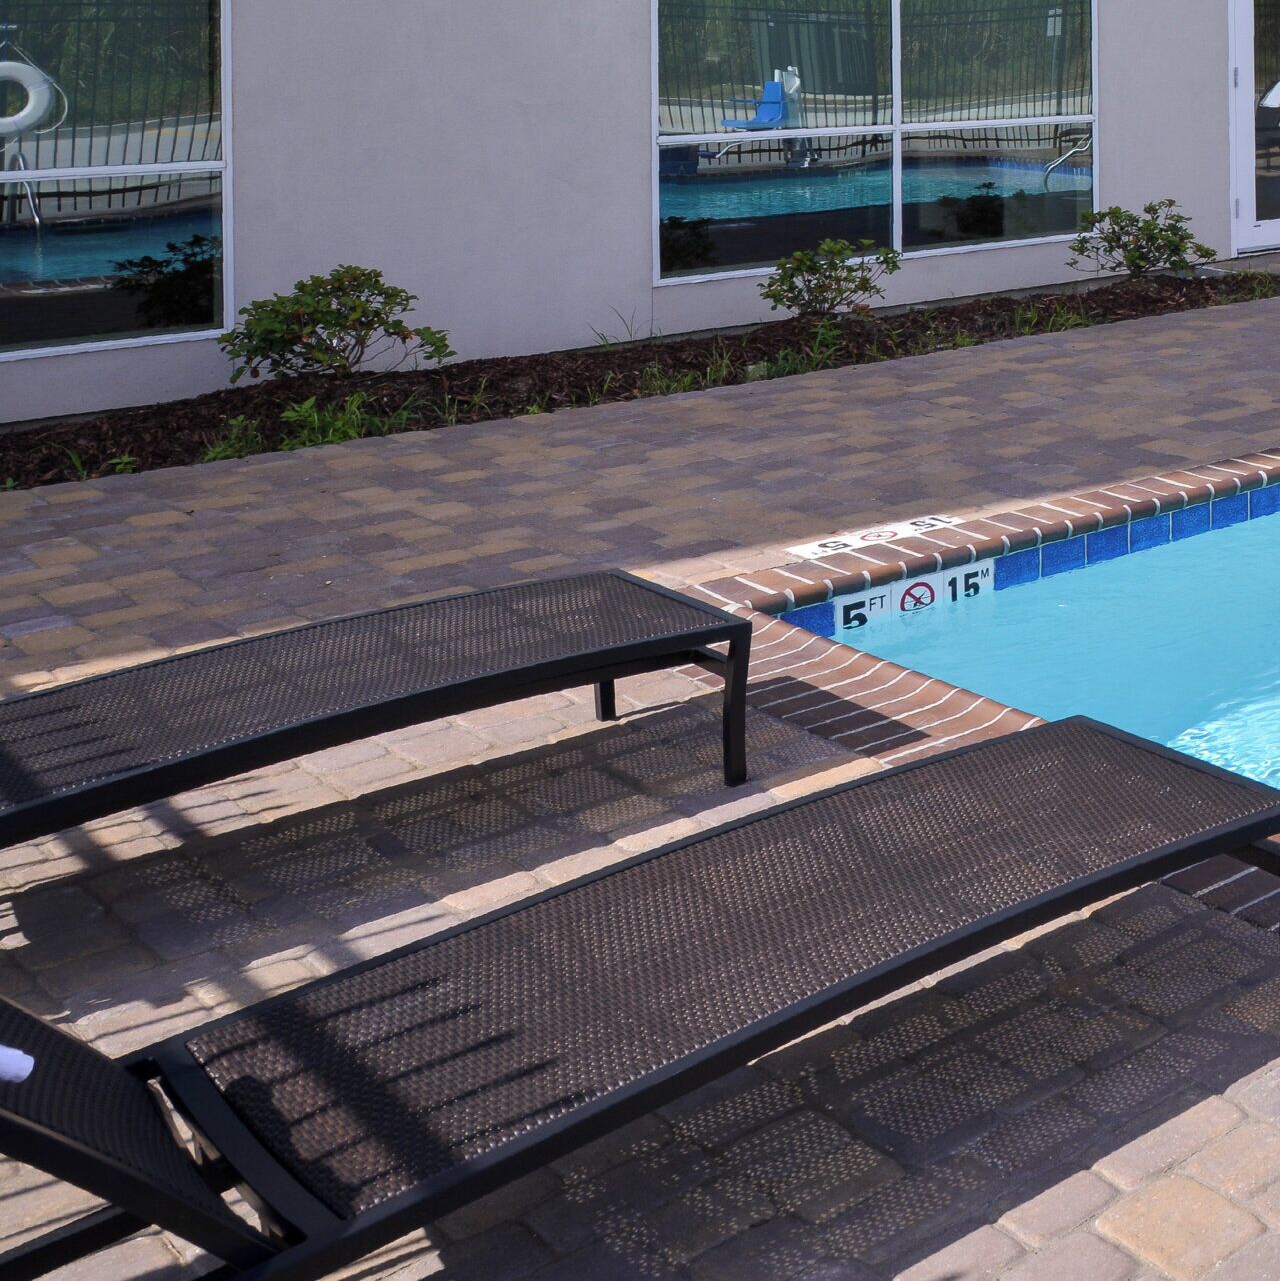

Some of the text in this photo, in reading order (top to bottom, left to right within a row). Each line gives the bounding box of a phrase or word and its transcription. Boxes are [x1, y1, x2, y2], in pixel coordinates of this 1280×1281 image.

[842, 600, 868, 629] 5
[869, 594, 887, 611] FT
[980, 567, 990, 580] M
